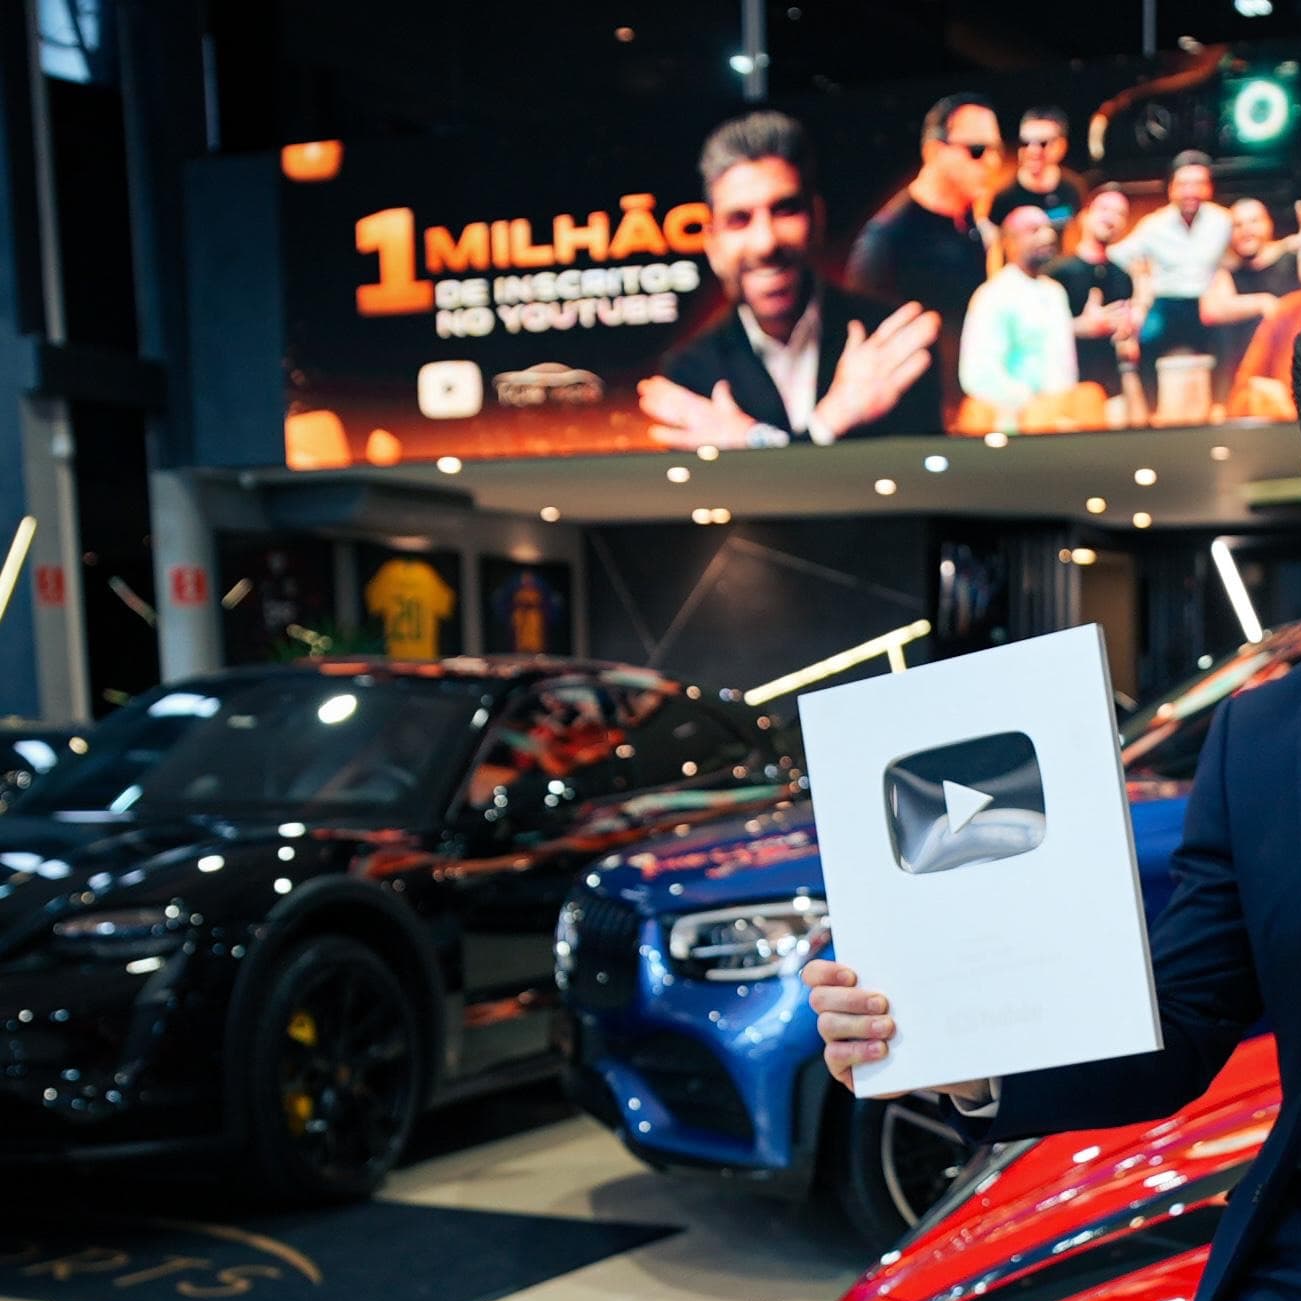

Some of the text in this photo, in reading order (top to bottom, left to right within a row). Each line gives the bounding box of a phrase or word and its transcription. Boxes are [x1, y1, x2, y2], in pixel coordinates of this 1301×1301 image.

[355, 193, 714, 317] 1 MILHÃO
[435, 260, 700, 311] DE INSCRITOS
[435, 292, 679, 339] NO YOUTUBE
